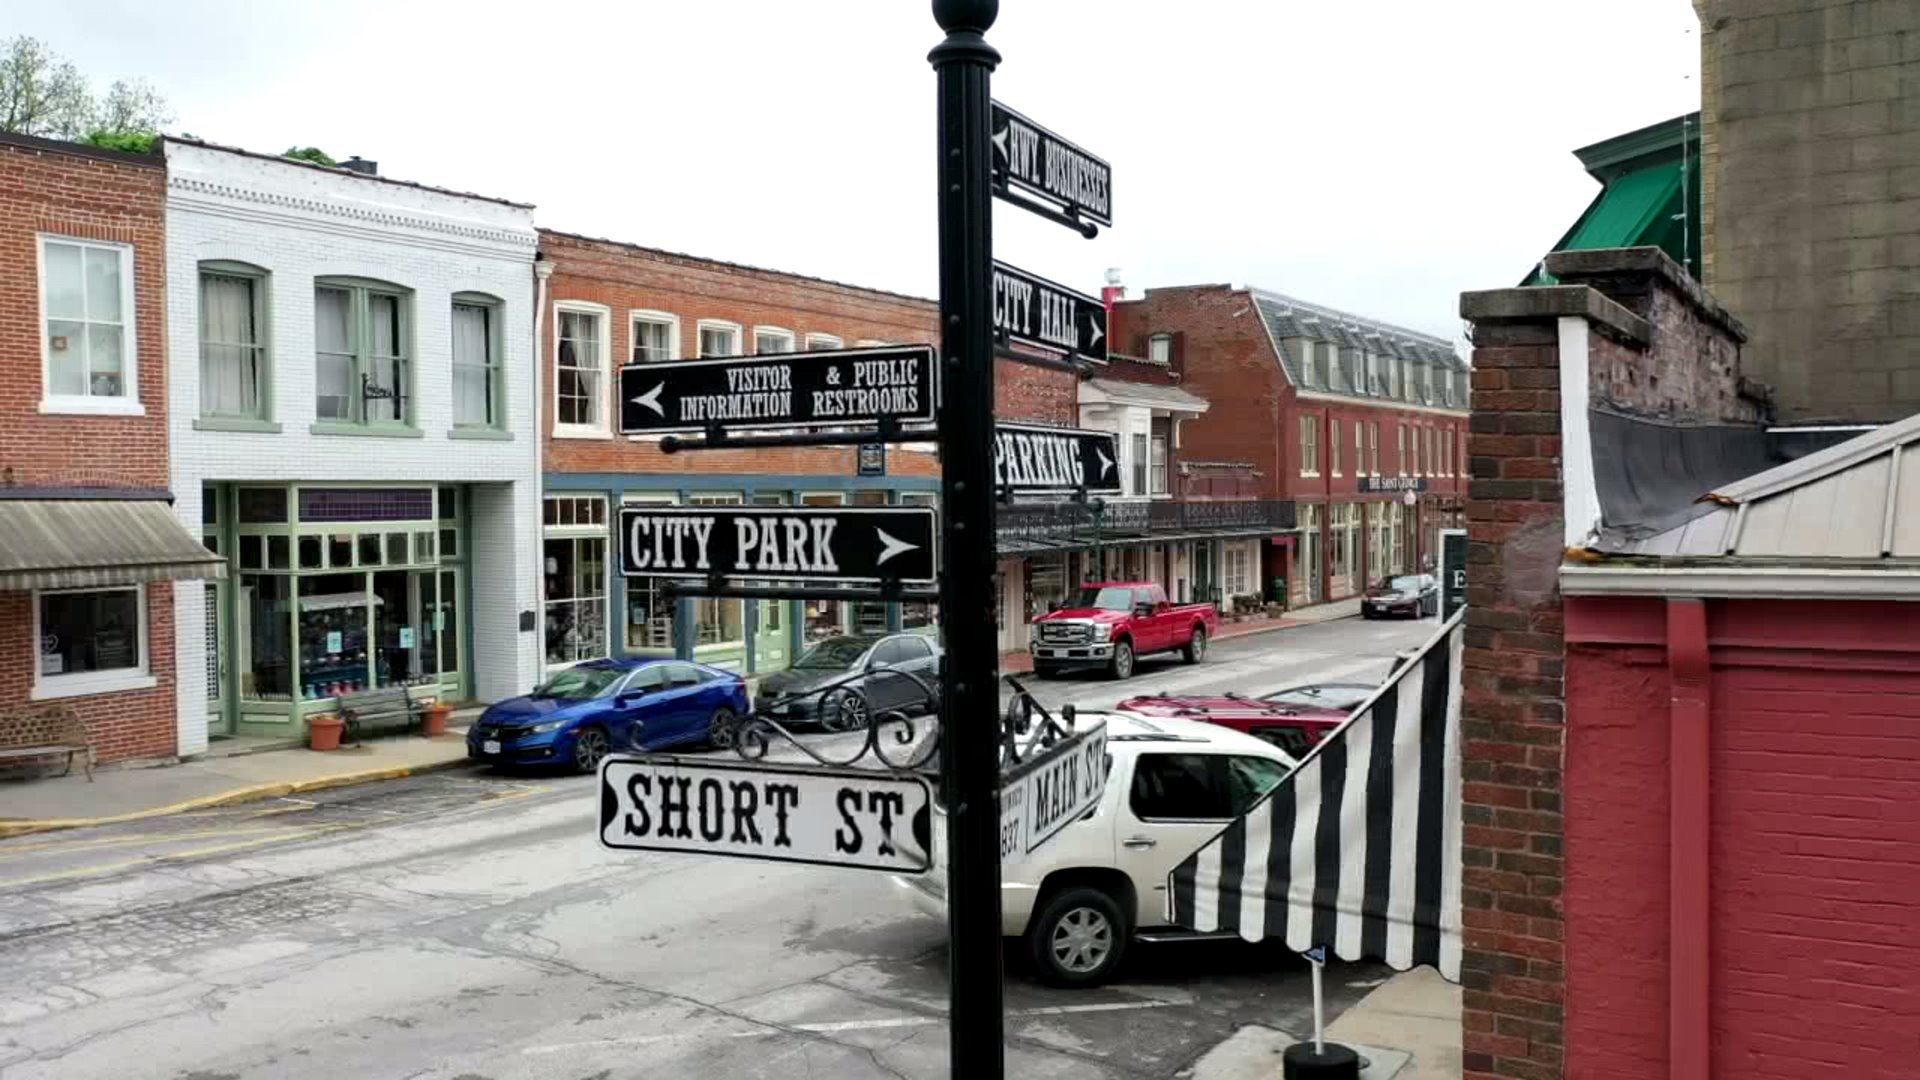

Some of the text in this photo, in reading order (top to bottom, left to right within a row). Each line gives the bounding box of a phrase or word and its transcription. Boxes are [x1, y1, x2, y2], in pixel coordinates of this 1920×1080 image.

[1009, 119, 1108, 215] HWY BUSINESSES
[993, 271, 1079, 349] CITY HALL
[726, 365, 792, 393] VISITOR
[826, 358, 918, 386] & PUBLIC
[680, 391, 792, 421] INFORMATION
[812, 387, 918, 417] RESTROOMS
[995, 433, 1083, 485] PARKING
[630, 516, 839, 572] CITY PARK
[1034, 737, 1103, 833] MAIN ST
[624, 773, 904, 856] SHORT ST
